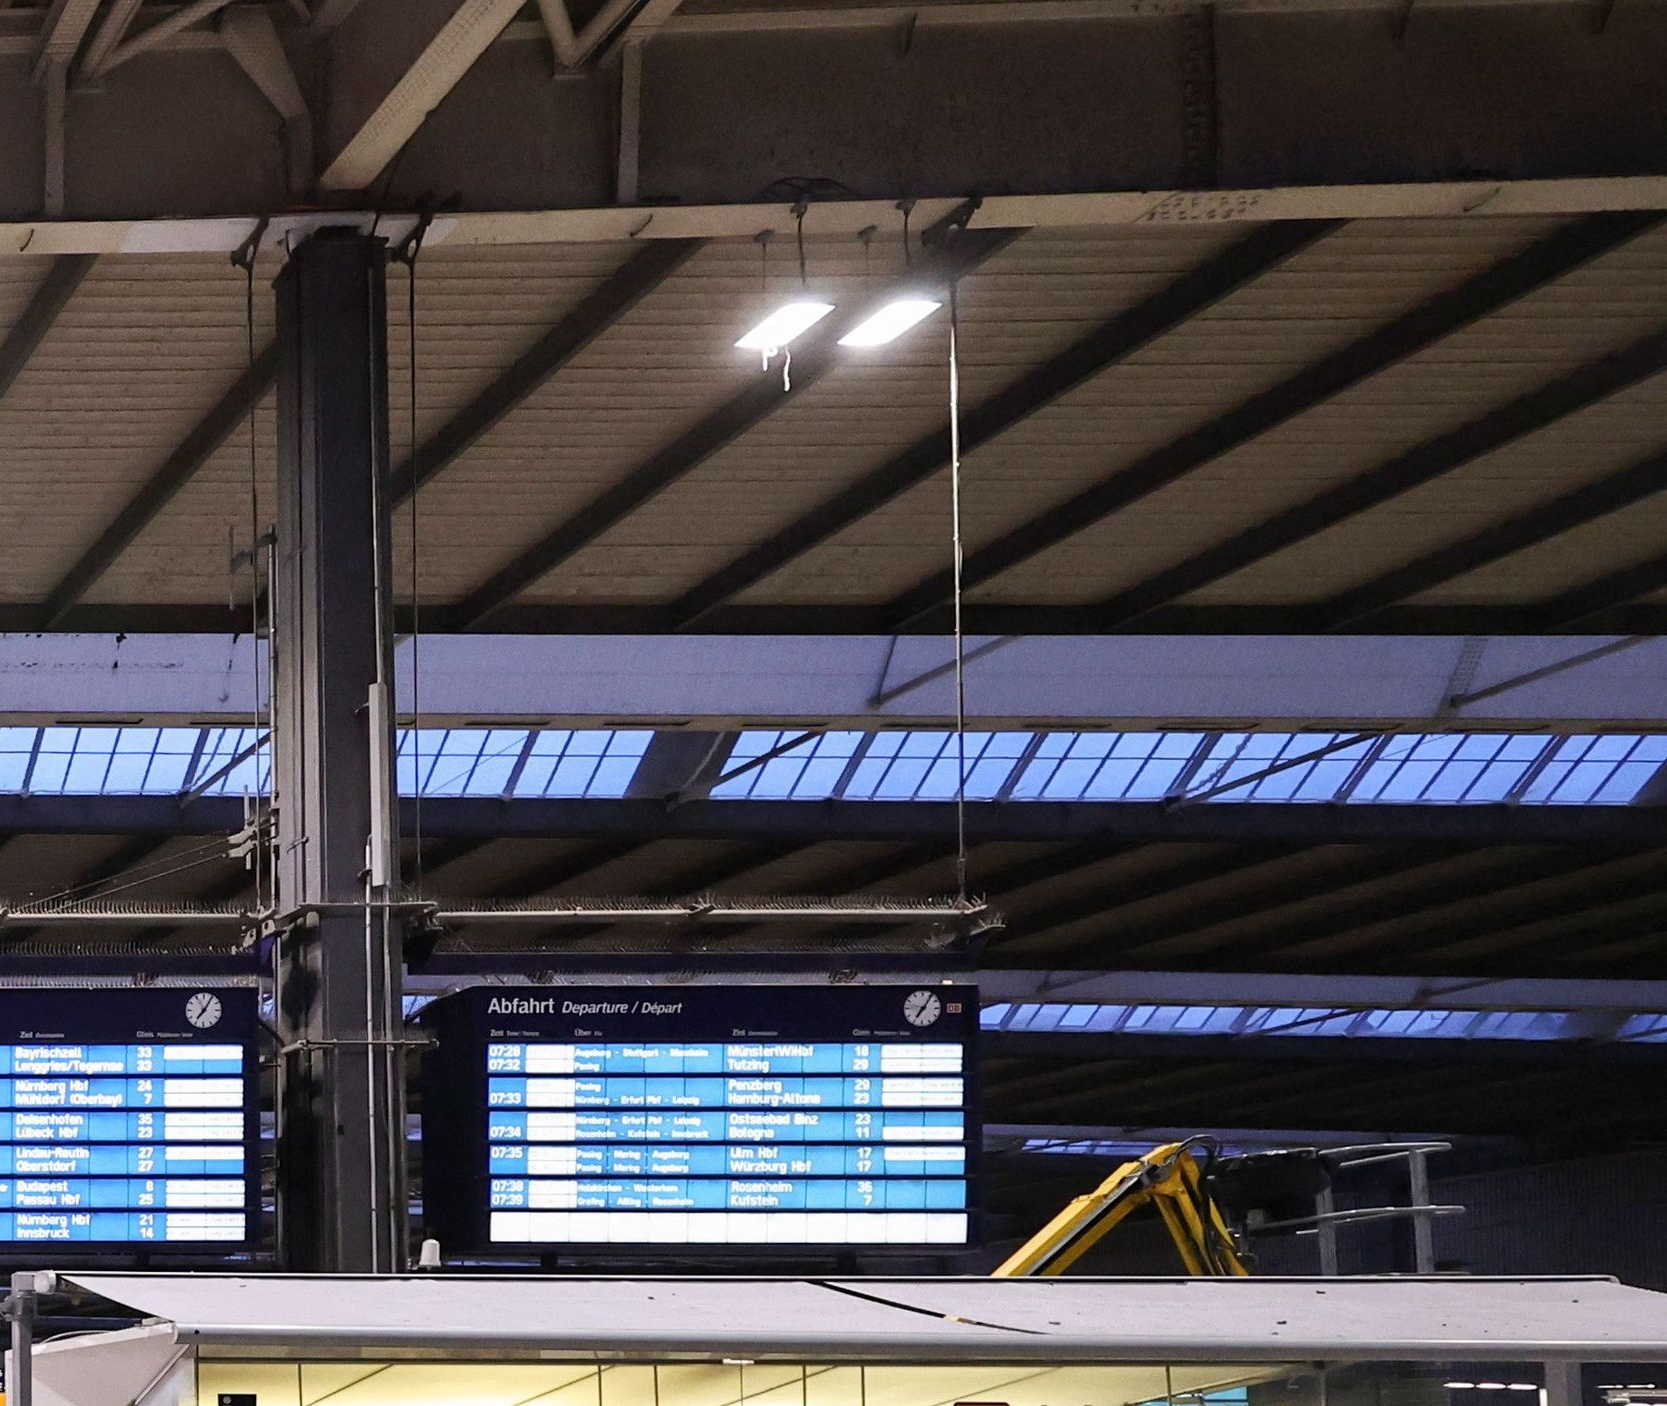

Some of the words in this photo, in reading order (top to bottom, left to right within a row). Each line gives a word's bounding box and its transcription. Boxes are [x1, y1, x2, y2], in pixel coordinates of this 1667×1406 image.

[488, 998, 555, 1014] Abfahrt
[562, 1001, 628, 1016] Departure
[641, 1001, 682, 1016] Départ
[138, 1047, 152, 1058] 33
[856, 1045, 869, 1056] 18
[137, 1061, 152, 1071] 33
[728, 1059, 769, 1072] Tutzing
[854, 1059, 869, 1070] 29
[16, 1081, 66, 1093] Nürnberg
[70, 1081, 88, 1091] Hbf
[138, 1080, 152, 1091] 24
[729, 1079, 782, 1093] Penzberg
[16, 1094, 65, 1105] Mühldorf
[145, 1094, 152, 1105] 7
[728, 1093, 821, 1107] Hamburg-Altona
[854, 1093, 870, 1104] 23
[16, 1114, 83, 1125] Deisenhofen
[139, 1114, 152, 1125] 35
[855, 1114, 870, 1125] 23
[16, 1127, 54, 1138] Lübeck
[59, 1127, 78, 1138] Hbf
[138, 1127, 152, 1138] 23
[729, 1127, 774, 1140] Bologna
[857, 1127, 869, 1138] 11
[139, 1147, 153, 1158] 27
[731, 1148, 753, 1158] Ulm
[758, 1148, 777, 1158] Hbf
[858, 1148, 872, 1158] 17
[16, 1161, 76, 1172] Oberstdorf
[138, 1161, 153, 1172] 27
[731, 1161, 787, 1174] Würzburg
[792, 1161, 811, 1172] Hbf
[858, 1161, 872, 1172] 17
[17, 1181, 67, 1193] Budapest
[732, 1182, 793, 1193] Rosenheim
[858, 1182, 873, 1193] 36
[17, 1194, 56, 1205] Passau
[61, 1194, 80, 1205] Hbf
[139, 1194, 153, 1205] 25
[731, 1195, 778, 1207] Kufstein
[864, 1195, 873, 1206] 7
[18, 1215, 67, 1227] Nürnberg
[72, 1215, 90, 1226] Hbf
[140, 1215, 152, 1225] 21
[17, 1227, 69, 1239] Innsbruck
[141, 1227, 153, 1238] 14
